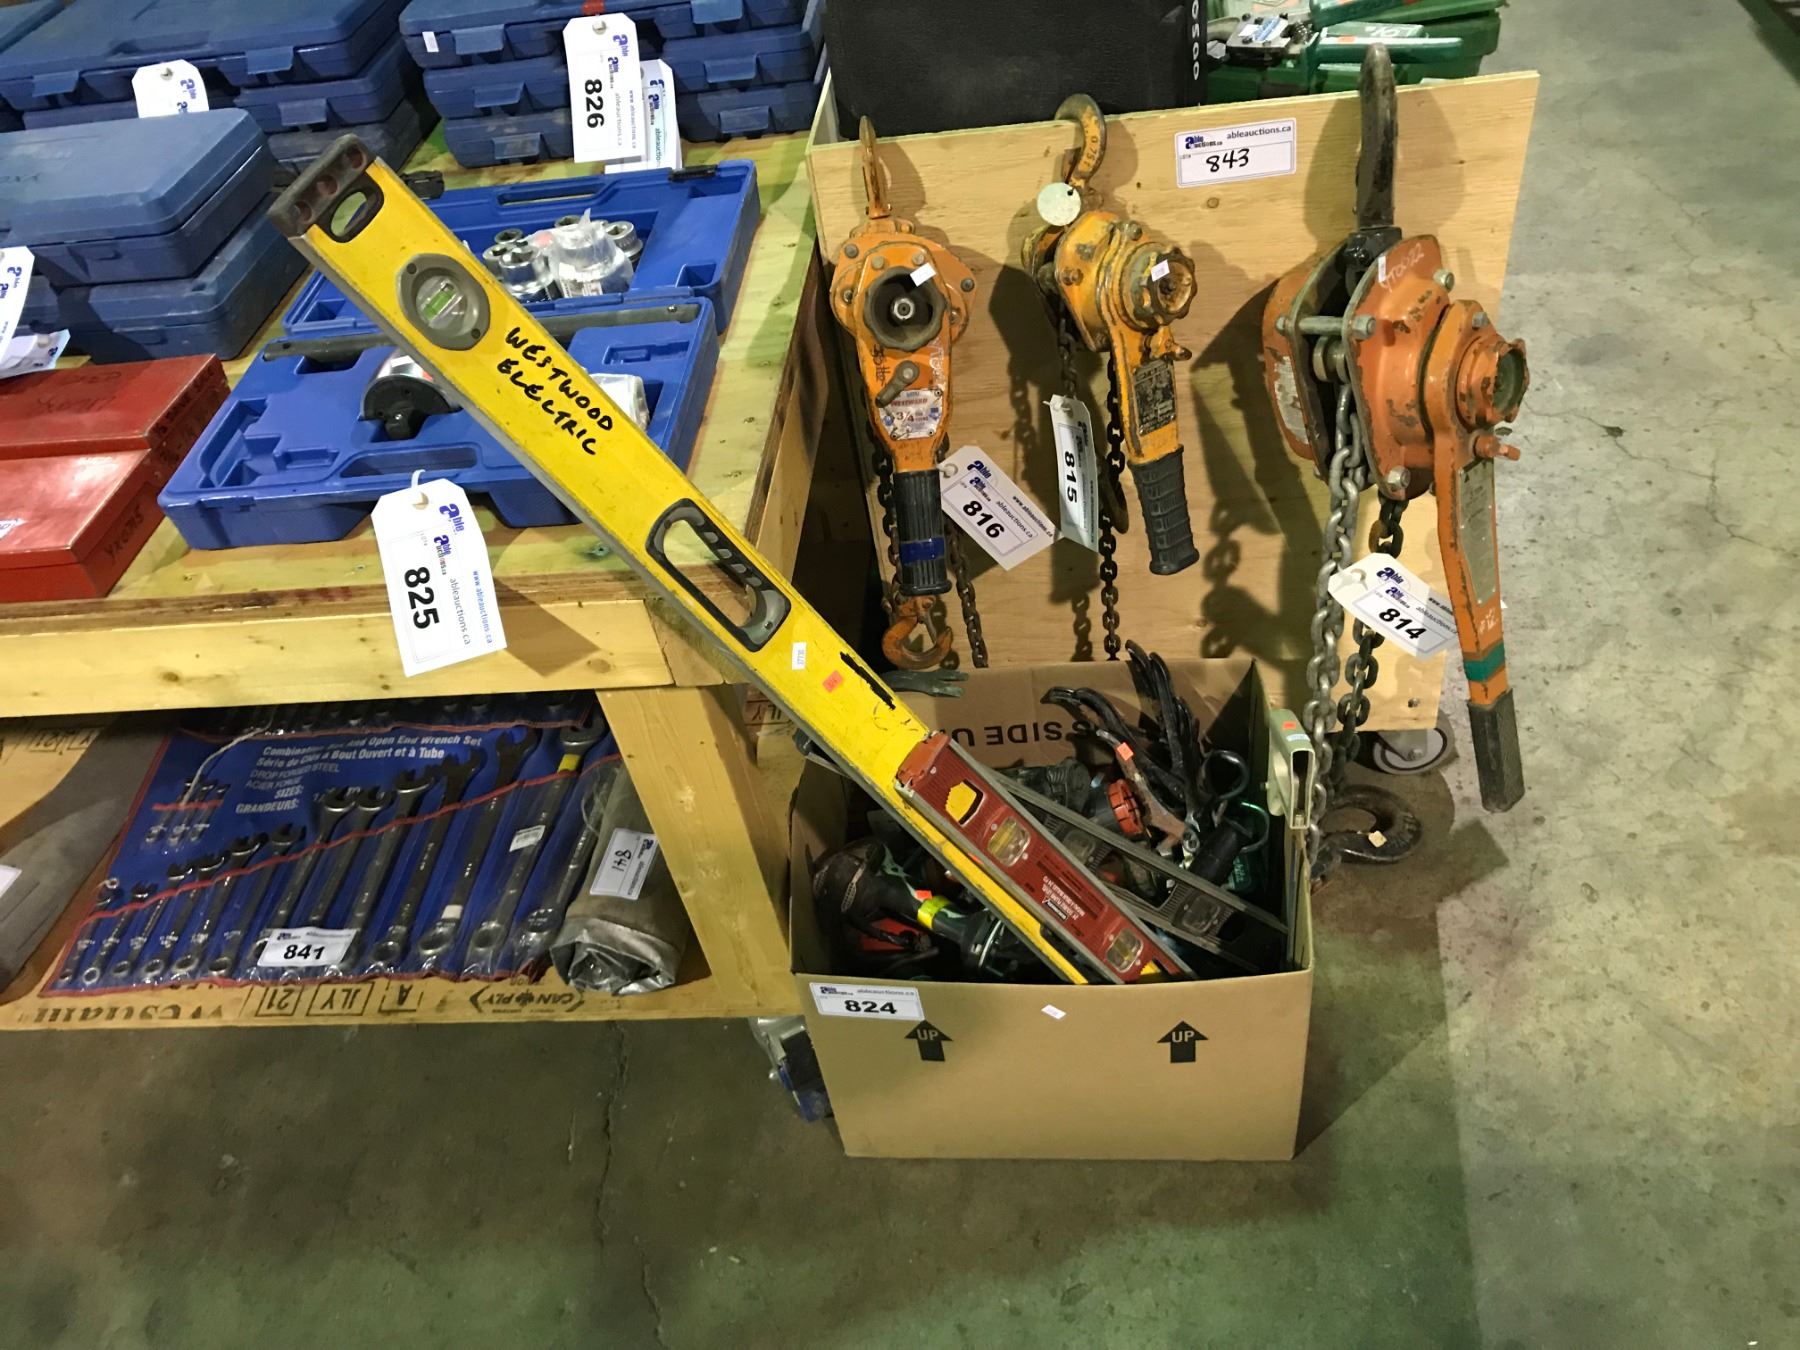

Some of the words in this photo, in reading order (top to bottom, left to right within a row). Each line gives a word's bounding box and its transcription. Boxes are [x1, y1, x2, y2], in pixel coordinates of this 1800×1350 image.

[585, 79, 605, 129] 826
[1226, 125, 1292, 140] ableauctions.ca
[1205, 148, 1250, 173] 843
[505, 327, 613, 431] WESTWOOD
[497, 358, 596, 456] ELECTRIC
[1064, 450, 1077, 504] 815
[438, 503, 465, 533] able
[962, 500, 1005, 539] 816
[404, 566, 440, 630] 825
[472, 570, 493, 645] www.ableauctions.ca
[449, 578, 471, 646] ableauctions.ca
[1379, 608, 1427, 640] 814
[369, 735, 395, 746] Open
[397, 735, 417, 744] End
[420, 734, 459, 745] Wrench
[463, 735, 482, 746] Set
[984, 721, 1062, 746] SIDE
[331, 749, 356, 760] Bout
[358, 748, 393, 759] Ouvert
[394, 749, 407, 757] et
[419, 747, 445, 758] Tube
[312, 762, 340, 773] STEEL
[283, 944, 325, 960] 841
[267, 988, 294, 1010] 21
[398, 984, 413, 1006] A
[482, 992, 514, 1006] PLY
[530, 992, 576, 1006] CAN
[844, 999, 897, 1015] 824
[916, 1029, 940, 1042] UP
[1172, 1030, 1196, 1043] UP
